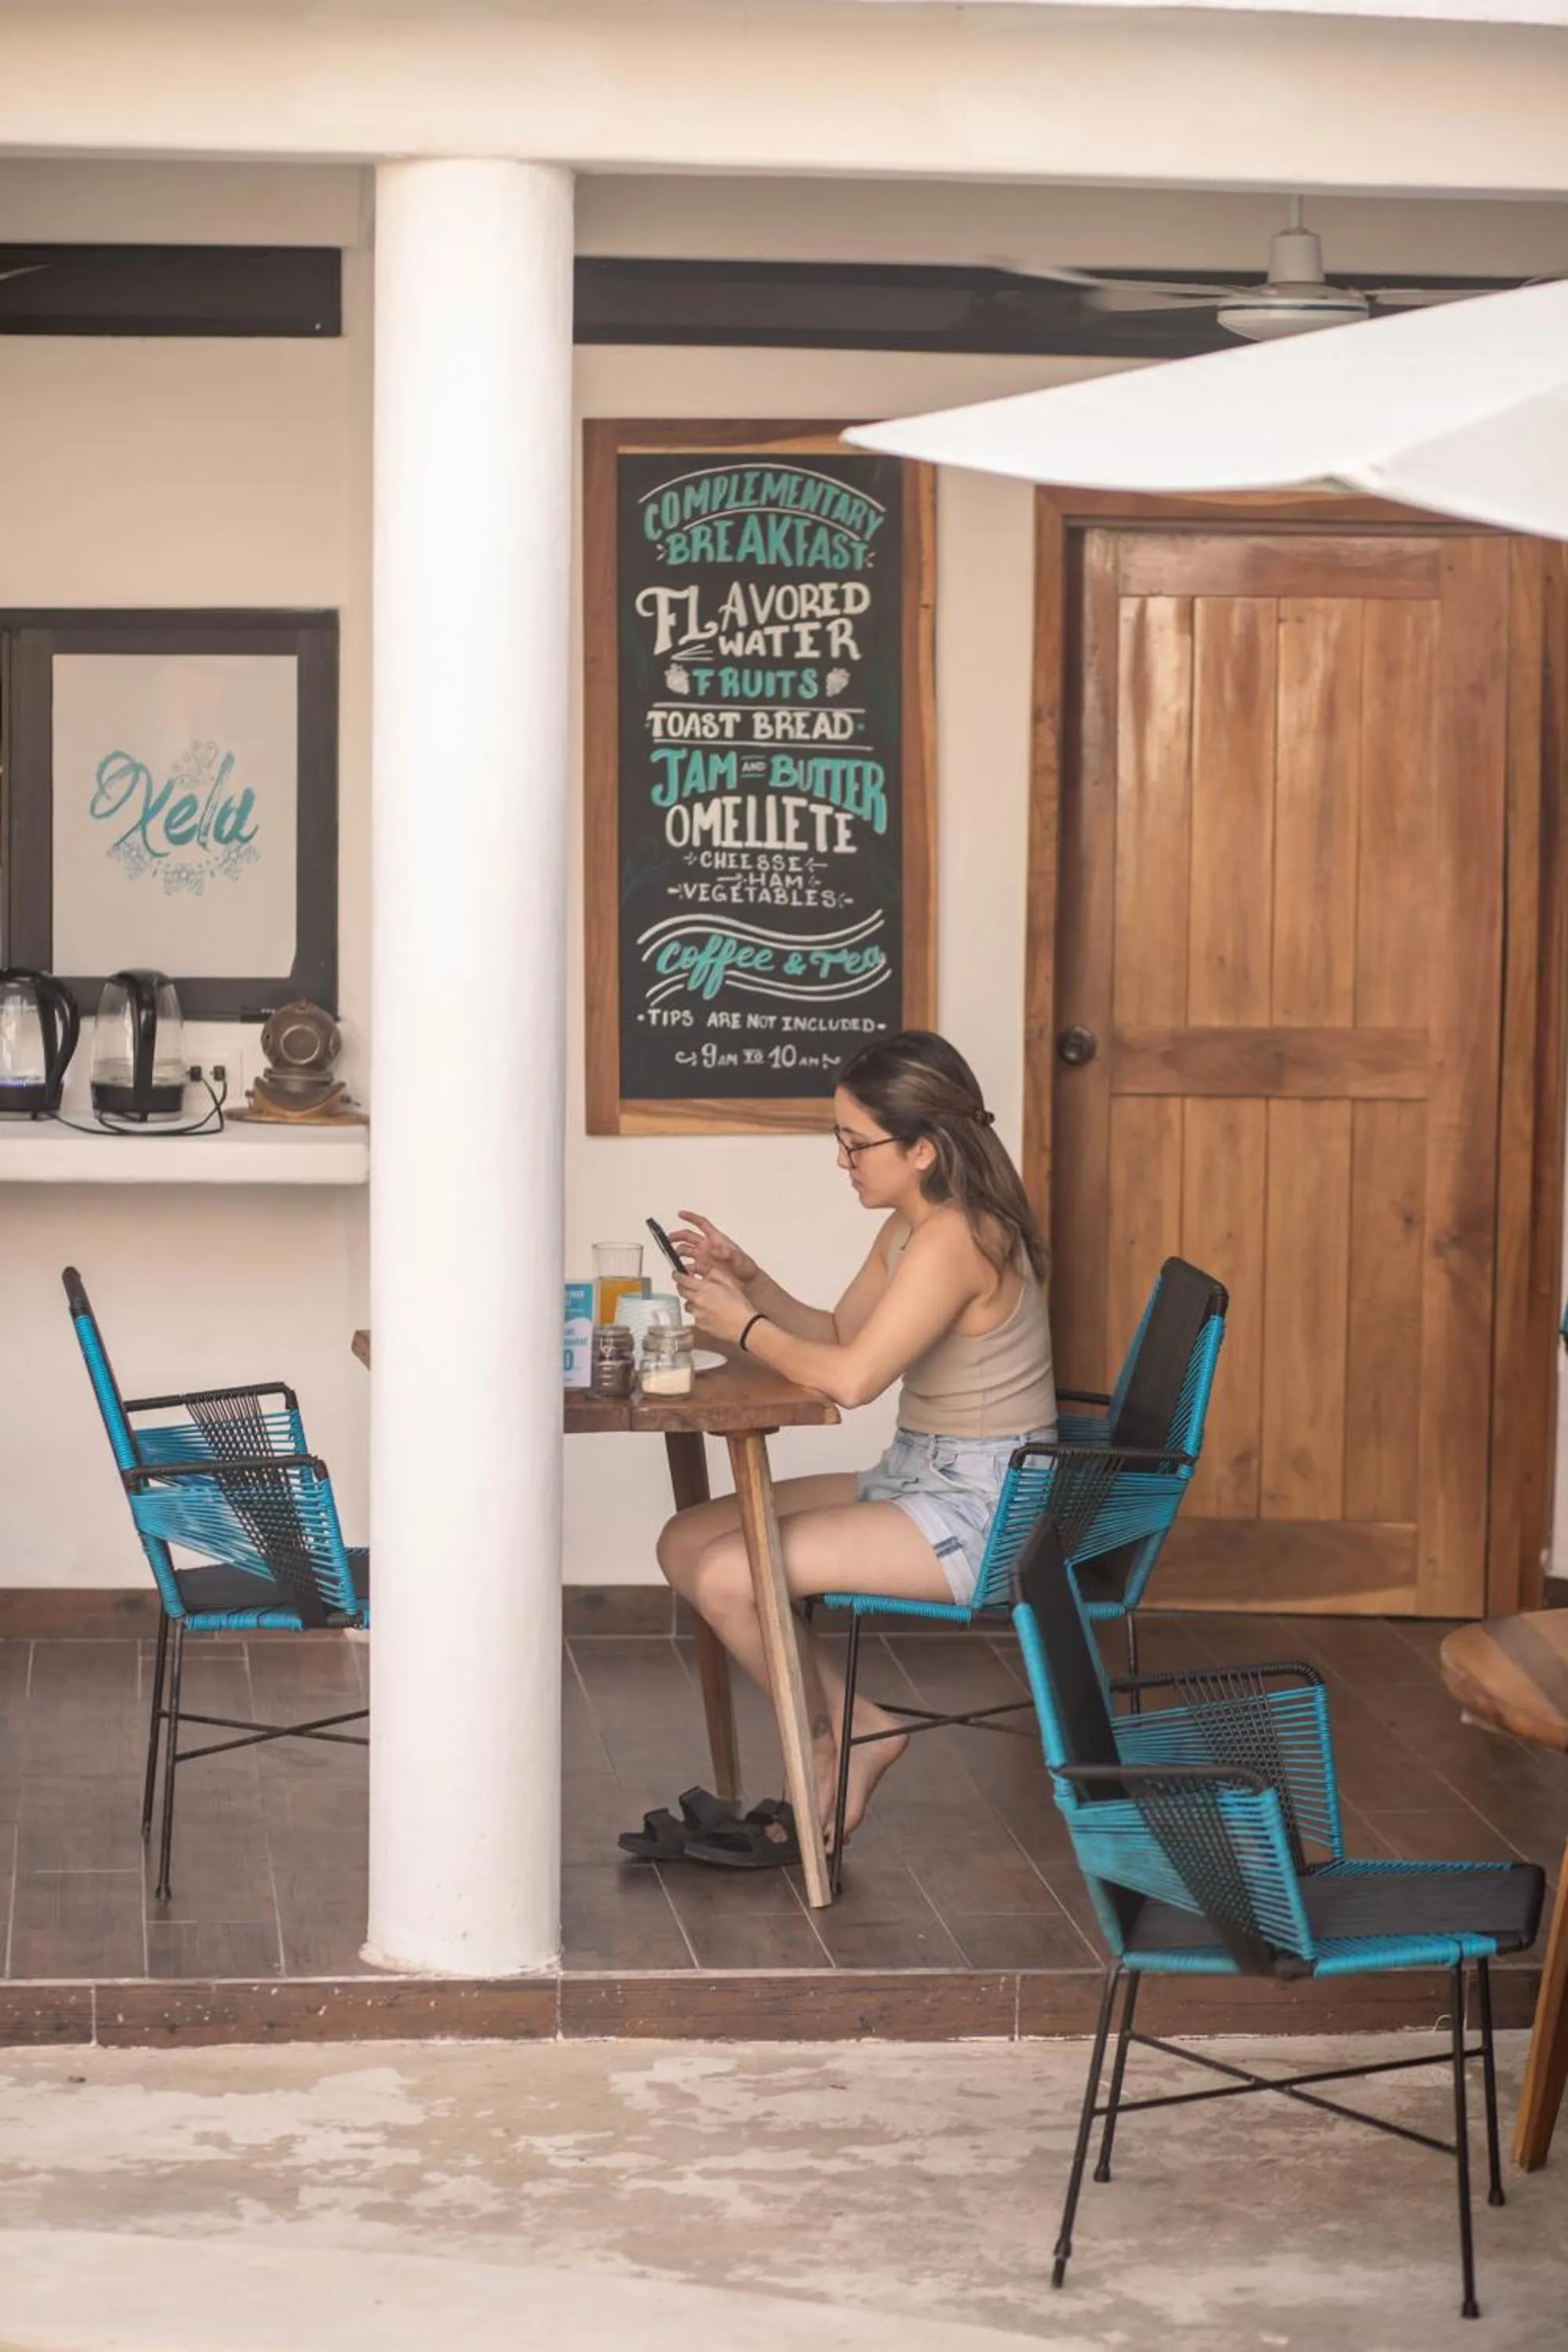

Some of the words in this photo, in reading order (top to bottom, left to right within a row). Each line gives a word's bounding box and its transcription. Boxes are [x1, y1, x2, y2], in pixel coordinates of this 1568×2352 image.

[644, 471, 884, 541] COMPLEMENTARY
[665, 514, 868, 570] BREAKFAST
[635, 581, 871, 655] FLAVORED
[718, 618, 861, 661] WATER
[692, 666, 818, 699] FRUITS
[646, 711, 742, 739] TOAST
[753, 711, 854, 740] BREAD
[650, 748, 739, 807] JAM
[741, 761, 766, 773] AND
[768, 754, 887, 835] BUTTER
[666, 794, 858, 854] OMELLETE
[683, 882, 837, 908] VEGETABLES
[749, 872, 804, 890] HAM
[655, 934, 775, 1000] Coffee
[782, 952, 807, 977] &
[809, 945, 887, 978] Tea
[648, 1008, 695, 1028] TIPS
[706, 1012, 742, 1030] ARE
[746, 1014, 776, 1030] NOT
[781, 1015, 876, 1033] INCLUDED
